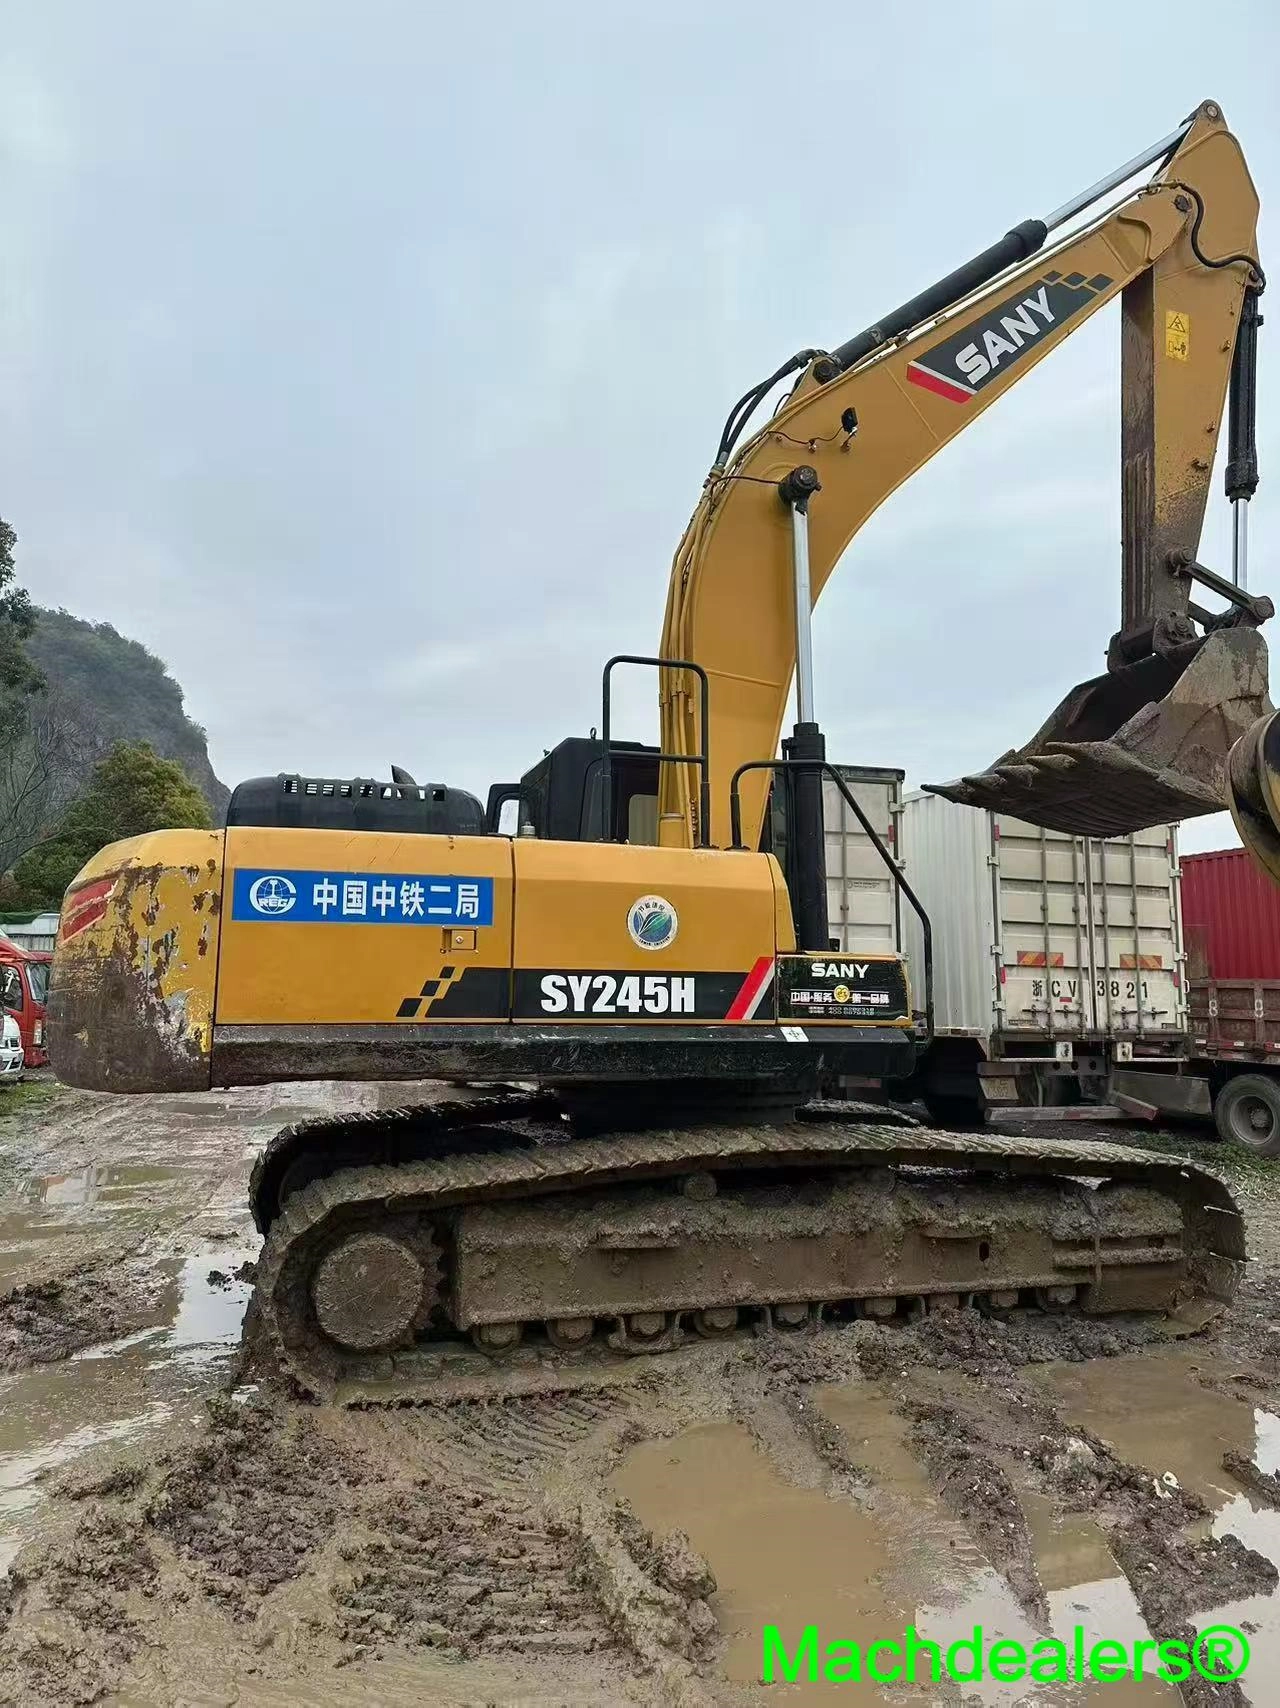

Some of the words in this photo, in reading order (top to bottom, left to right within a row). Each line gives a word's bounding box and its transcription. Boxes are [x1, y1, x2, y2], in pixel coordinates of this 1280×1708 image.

[955, 286, 1056, 385] SANY
[312, 878, 480, 919] 中国中铁二局
[811, 963, 870, 979] SANY
[540, 974, 696, 1013] SY245H
